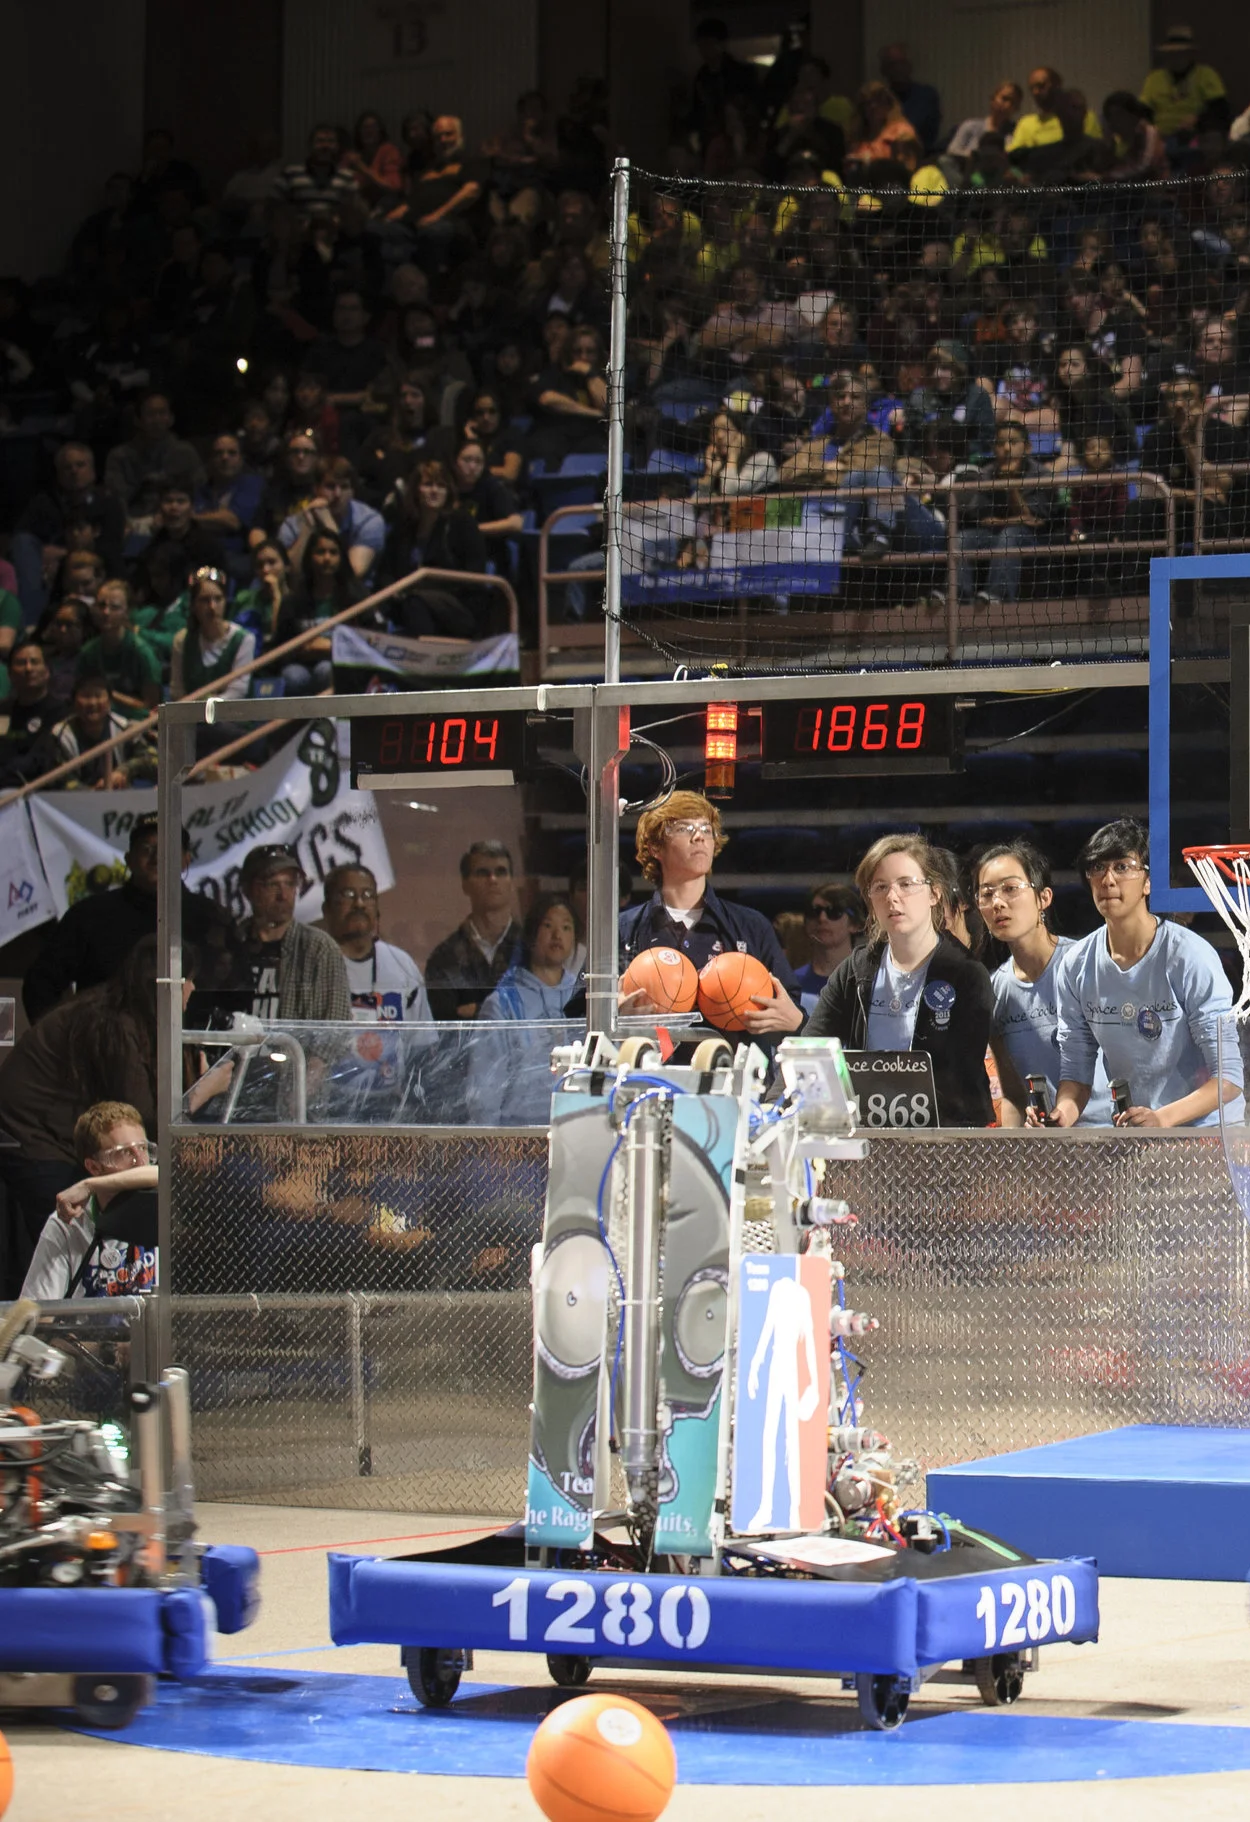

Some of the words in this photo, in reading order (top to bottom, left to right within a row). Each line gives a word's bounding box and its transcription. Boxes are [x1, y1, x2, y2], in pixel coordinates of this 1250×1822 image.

[426, 719, 498, 765] 104
[812, 703, 925, 751] 1868
[872, 1055, 928, 1073] Cookies
[852, 1092, 931, 1128] 1868
[492, 1577, 711, 1650] 1280
[976, 1574, 1076, 1650] 1280
